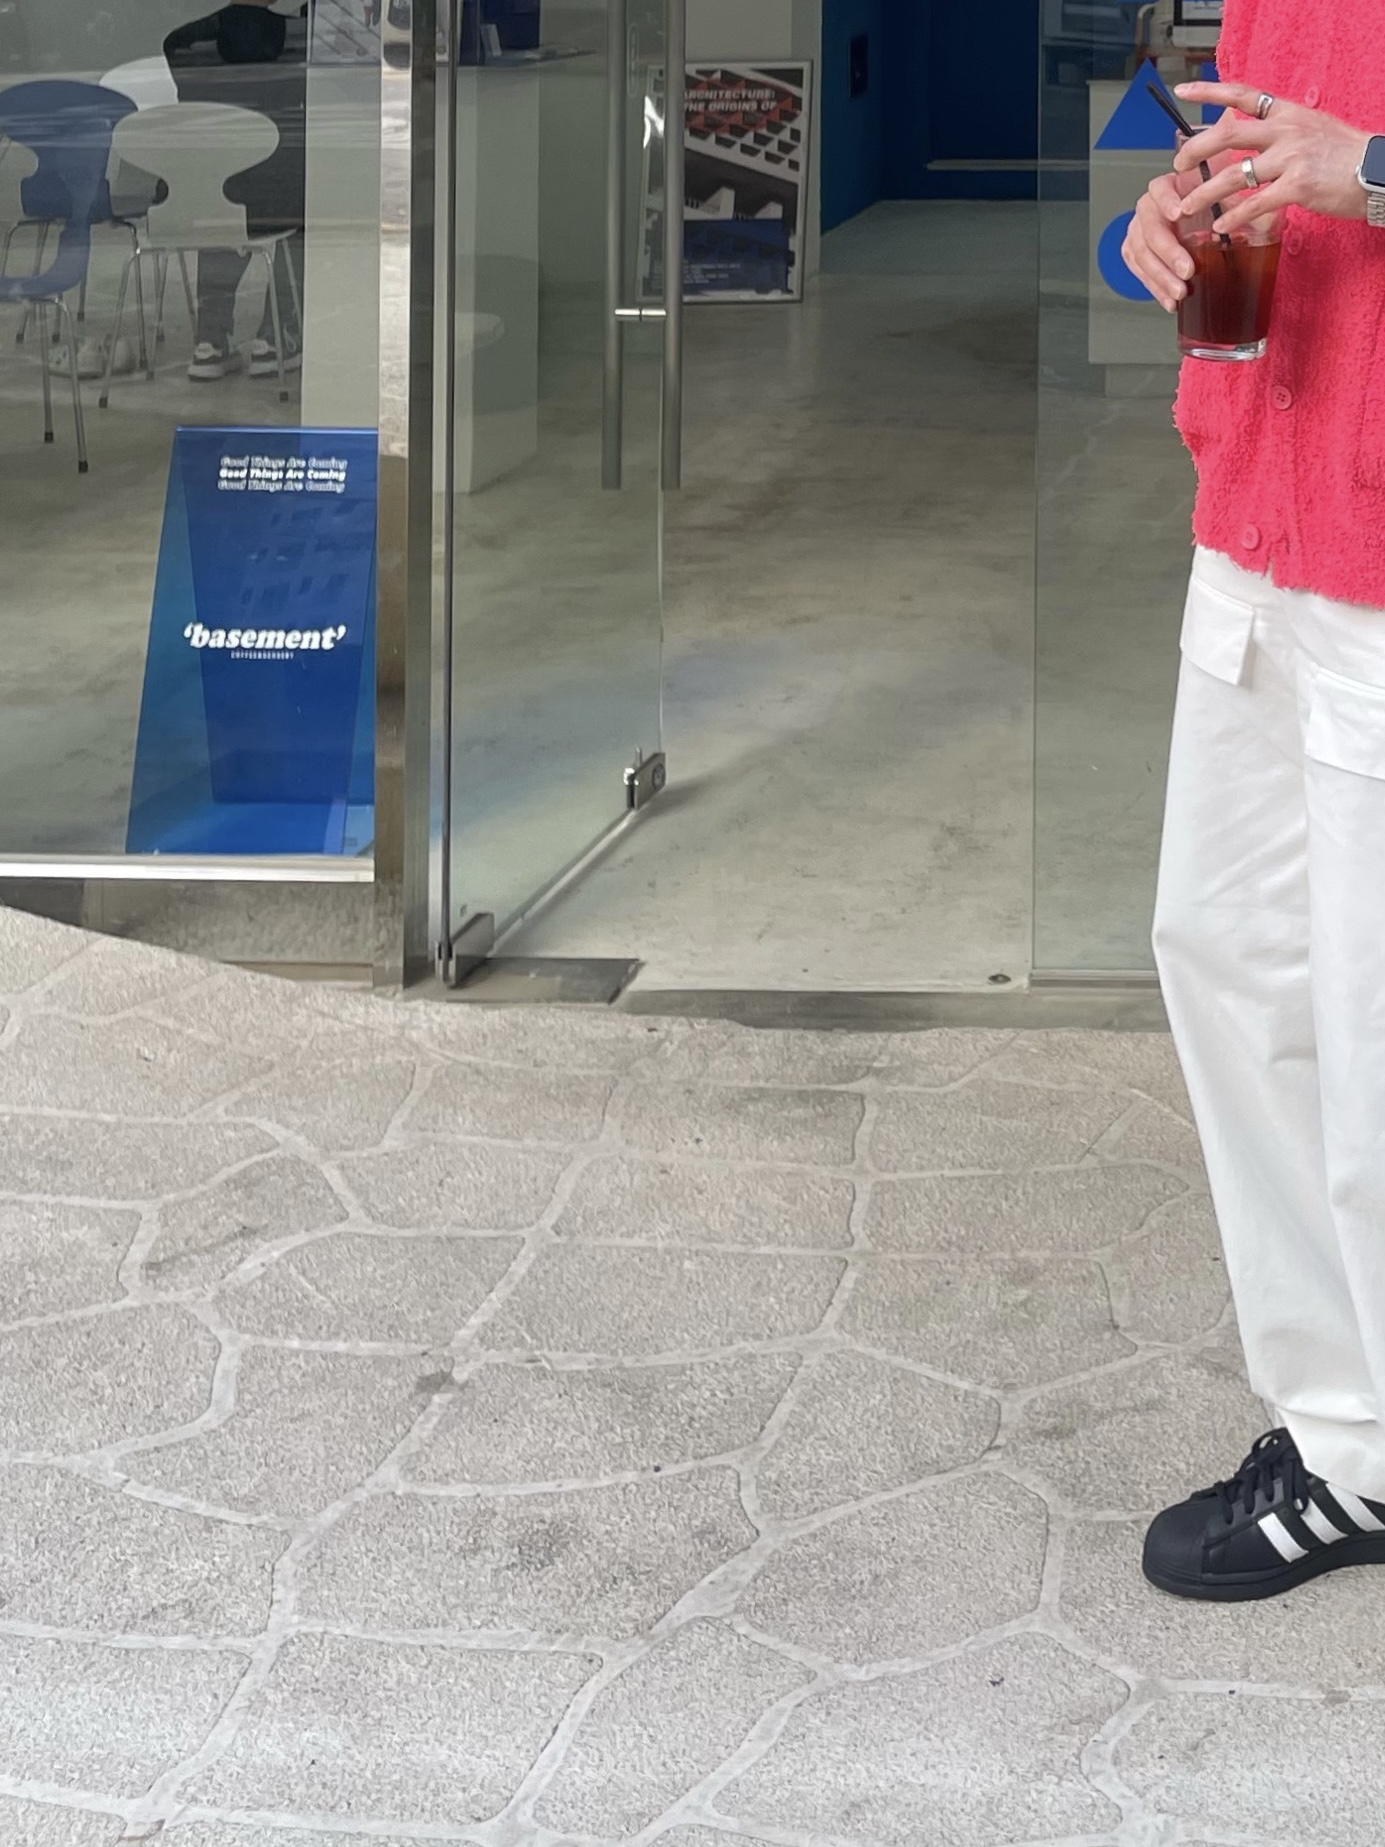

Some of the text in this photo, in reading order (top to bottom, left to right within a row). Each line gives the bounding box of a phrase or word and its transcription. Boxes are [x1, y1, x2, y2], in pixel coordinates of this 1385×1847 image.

[219, 468, 346, 481] Good Things Are Coming
